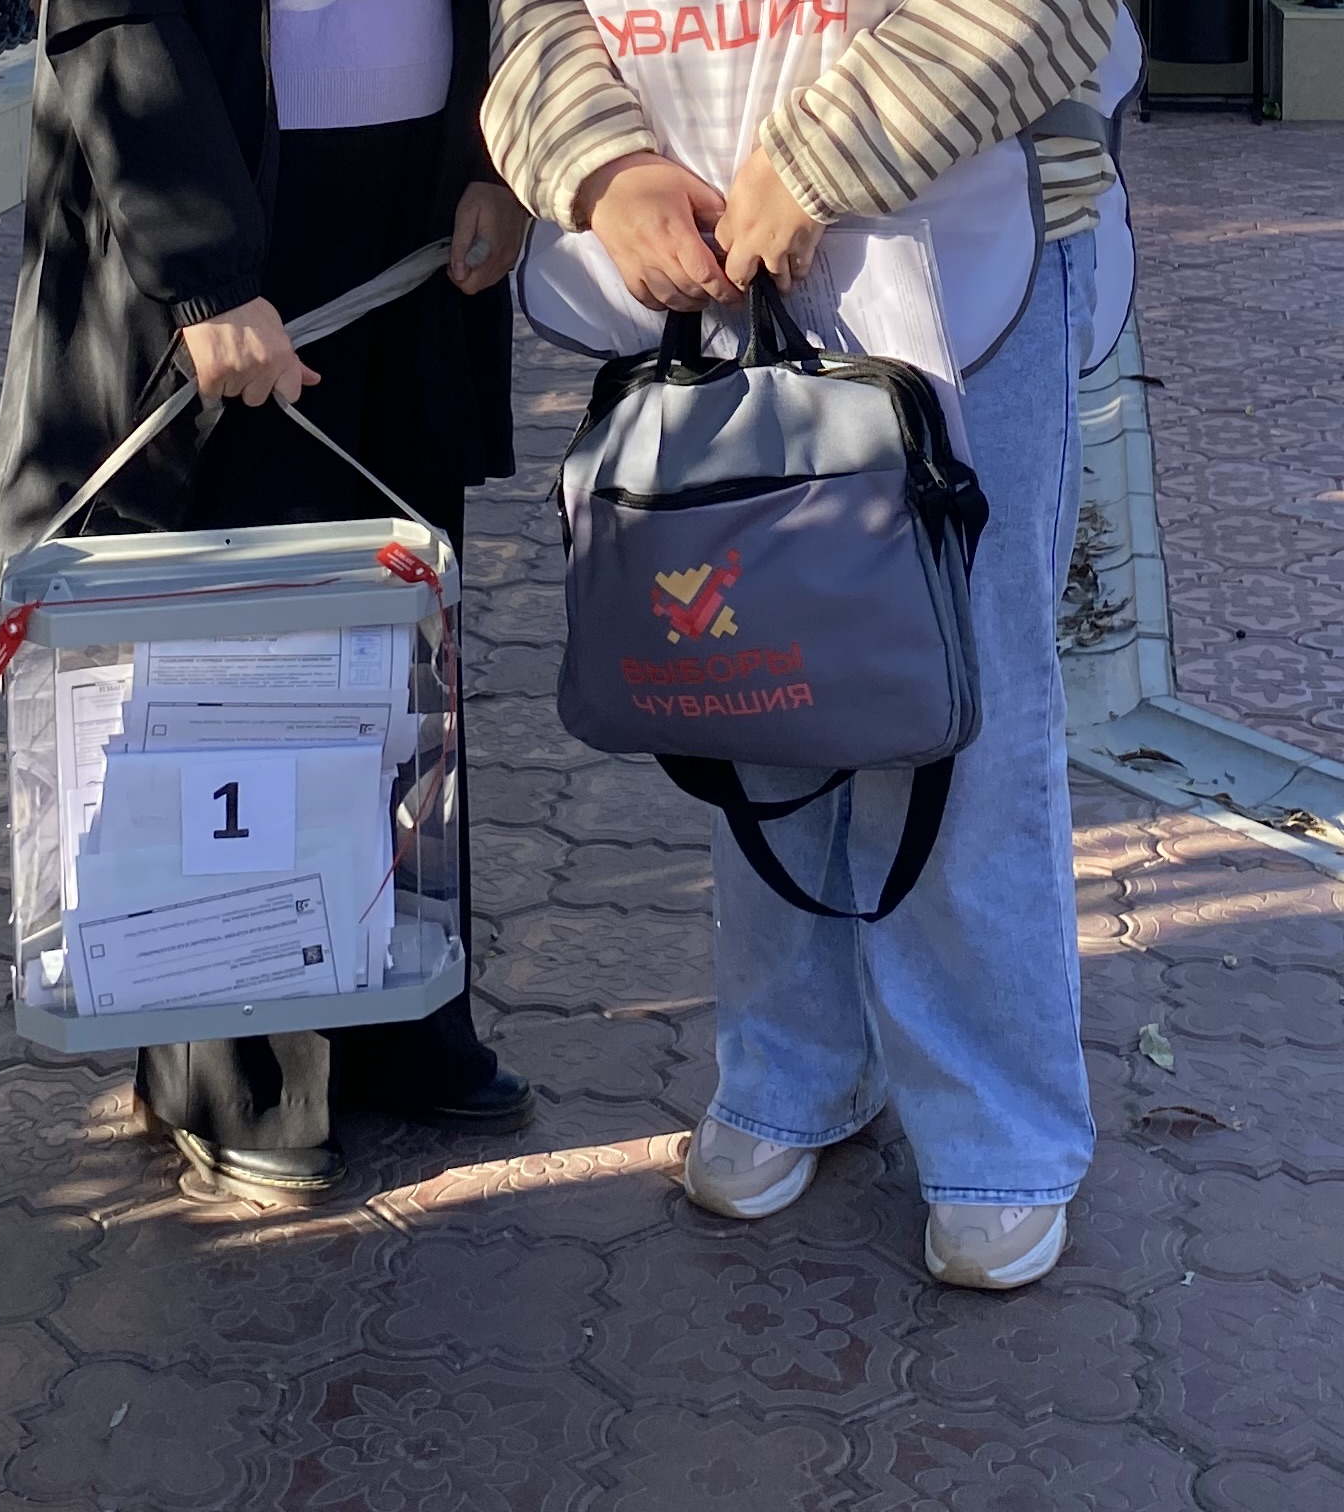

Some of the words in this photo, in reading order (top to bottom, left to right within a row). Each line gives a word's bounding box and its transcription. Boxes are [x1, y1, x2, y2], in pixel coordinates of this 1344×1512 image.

[619, 641, 805, 685] ВЫБОРЫ
[631, 682, 816, 718] ЧУВАШИЯ
[212, 780, 250, 840] 1
